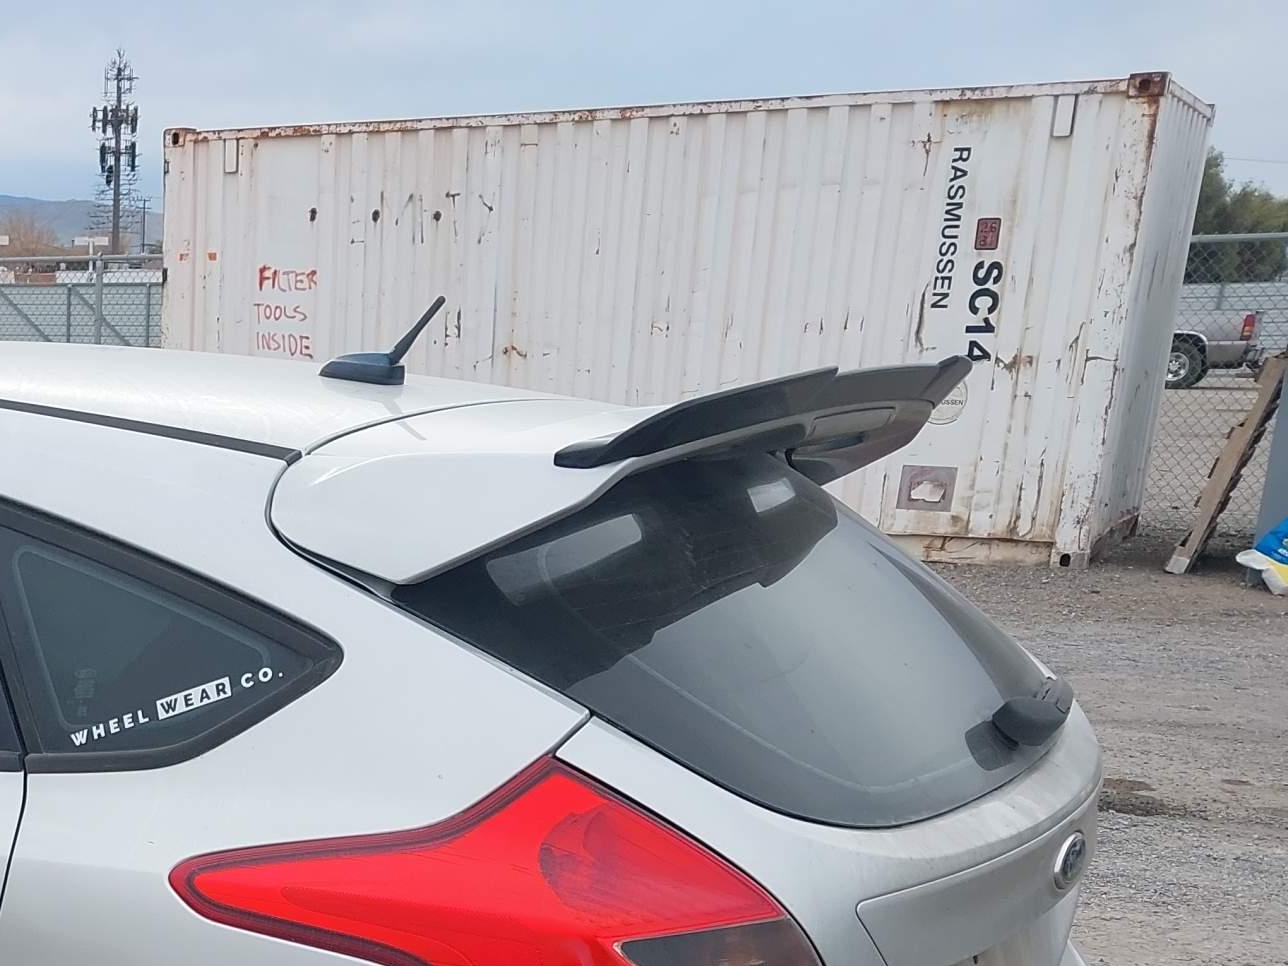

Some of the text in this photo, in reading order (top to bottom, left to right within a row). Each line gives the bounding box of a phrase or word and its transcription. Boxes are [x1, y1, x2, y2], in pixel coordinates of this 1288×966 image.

[930, 146, 972, 309] RASMUSSEN
[258, 264, 318, 292] FILTER
[253, 303, 308, 325] TOOLS
[965, 260, 1004, 361] SC14
[256, 331, 313, 359] INSIDE
[69, 666, 284, 746] WHEEL WEAR CO.
